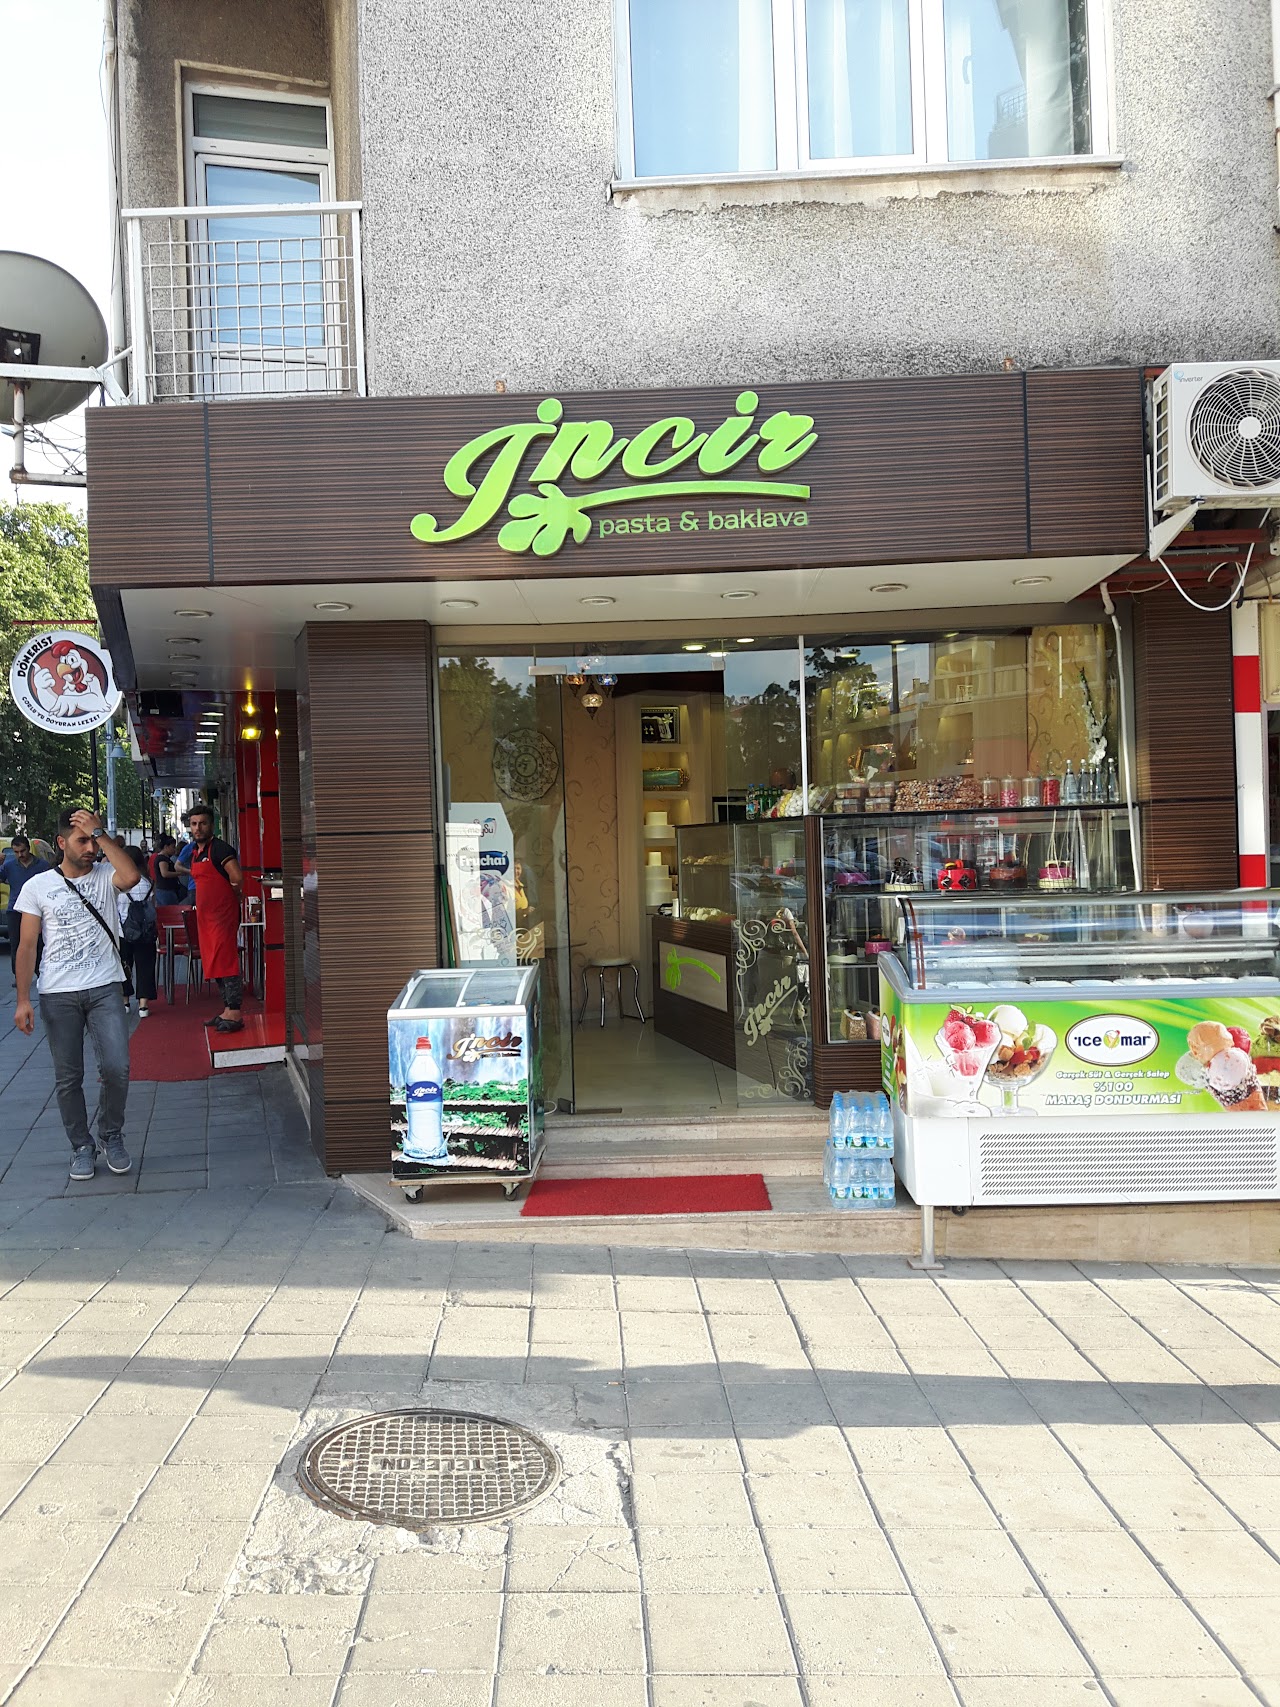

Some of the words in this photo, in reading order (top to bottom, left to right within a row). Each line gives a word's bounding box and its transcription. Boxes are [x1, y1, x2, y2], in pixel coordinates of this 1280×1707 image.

[598, 513, 670, 538] pasta
[679, 511, 699, 532] &
[708, 508, 809, 531] baklava
[16, 636, 54, 678] DÖNERİST
[45, 717, 76, 727] DOYURAN
[78, 714, 101, 725] LEZZET
[1056, 1071, 1087, 1080] Gerçek
[1088, 1070, 1103, 1079] Süt
[1104, 1071, 1113, 1079] &
[1114, 1070, 1144, 1080] Gerçek
[1146, 1070, 1170, 1079] Salep
[1093, 1082, 1134, 1092] %100
[1045, 1095, 1093, 1108] MARAŞ
[1094, 1093, 1182, 1105] DONDURMASI
[380, 1457, 487, 1472] TELEFON
